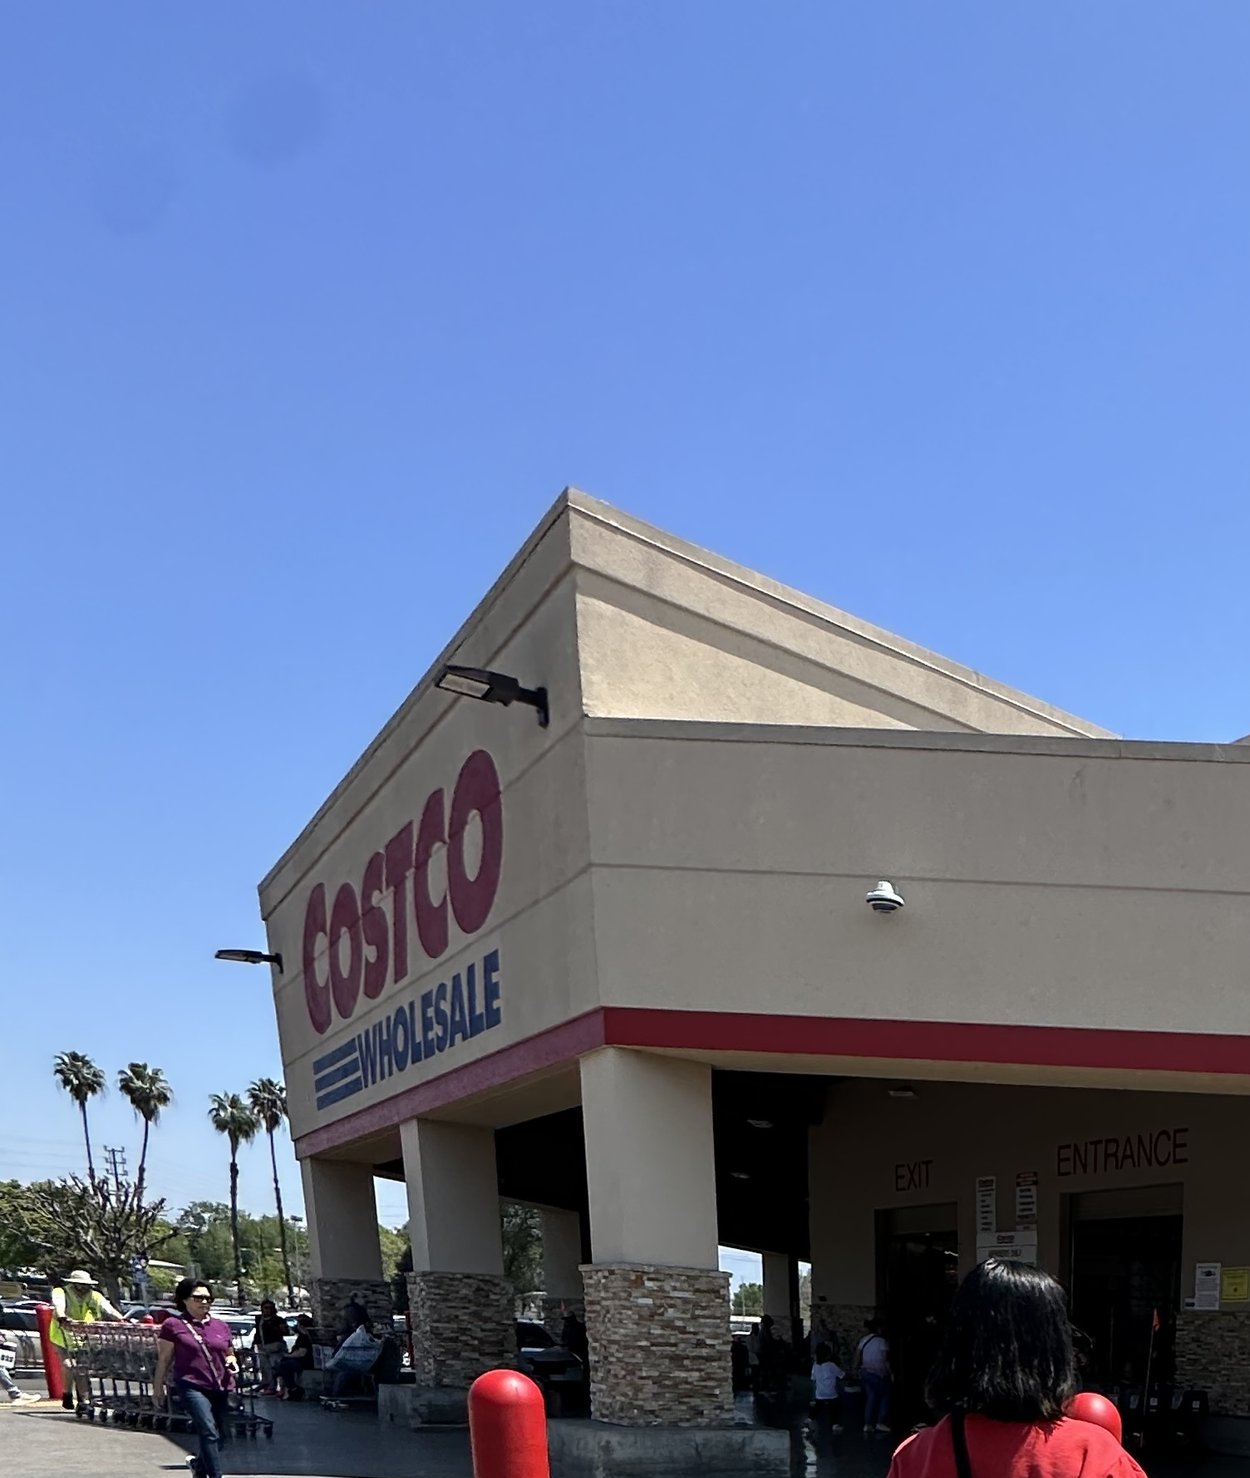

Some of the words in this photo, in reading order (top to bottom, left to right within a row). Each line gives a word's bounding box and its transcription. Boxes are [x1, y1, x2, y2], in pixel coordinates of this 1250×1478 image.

[304, 749, 503, 1034] COSTCO
[357, 948, 501, 1088] WHOLESALE
[895, 1160, 934, 1192] EXIT
[1057, 1128, 1189, 1177] ENTRANCE
